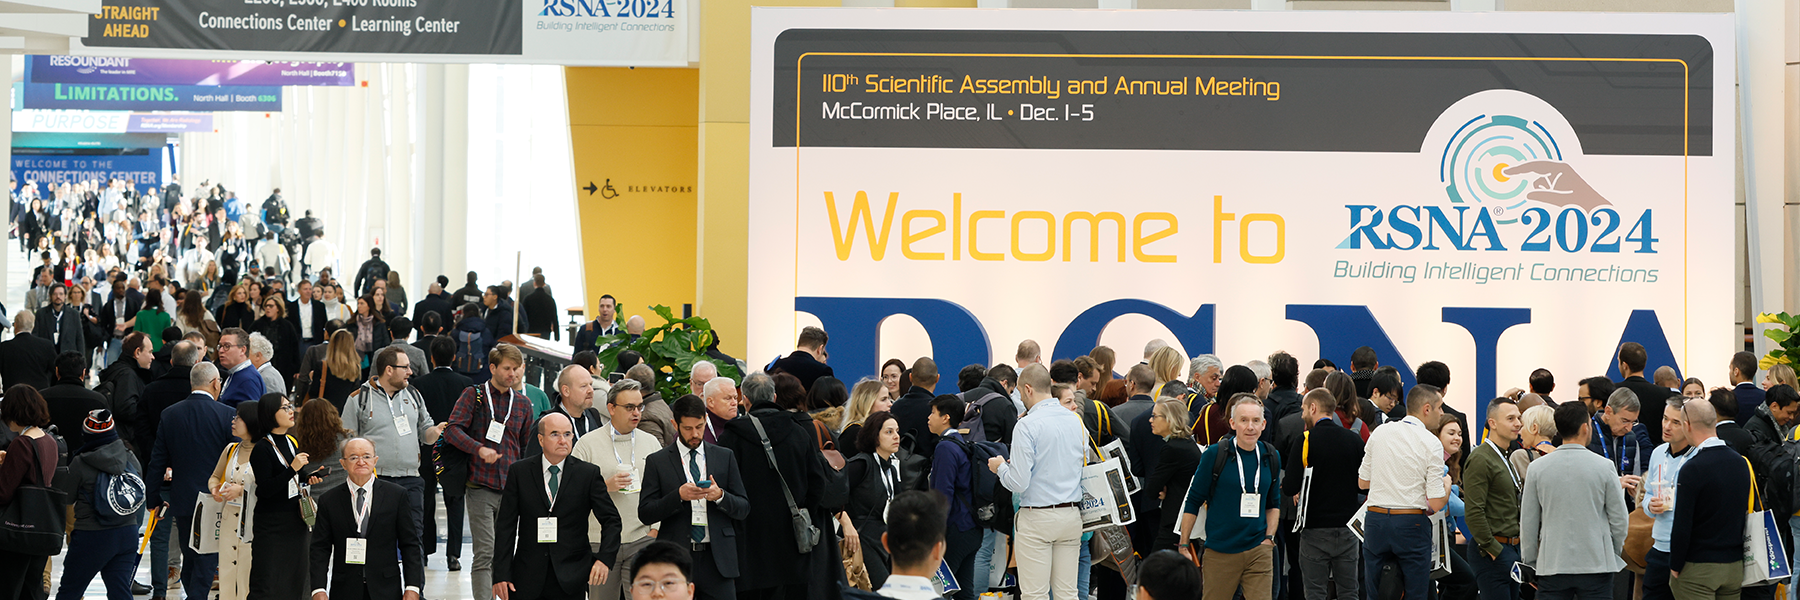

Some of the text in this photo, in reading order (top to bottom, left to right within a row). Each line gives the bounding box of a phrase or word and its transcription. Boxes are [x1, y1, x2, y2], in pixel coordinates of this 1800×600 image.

[537, 0, 675, 18] RSNA 2024
[103, 23, 149, 38] AHEAD
[198, 11, 460, 36] Connections Center Learning Center
[536, 21, 675, 32] Building Intelligent Connections
[50, 54, 130, 67] RESOUNDANT
[55, 83, 179, 102] LIMITATIONS.
[822, 73, 1280, 101] 110th Scientific Assembly and Annual Meeting
[193, 94, 213, 102] North
[215, 94, 229, 102] Hall
[235, 94, 257, 103] Booth
[822, 102, 920, 121] McCormick
[927, 103, 980, 122] Place,
[986, 103, 1003, 120] IL
[1020, 104, 1059, 121] Dec.
[32, 114, 120, 129] PURPOSE
[15, 160, 113, 169] WELCOME TO THE
[23, 170, 107, 183] CONNECTIONS
[109, 171, 157, 184] CENTER
[628, 185, 692, 193] ELEVATORS
[823, 190, 1286, 264] Welcome to
[1520, 207, 1660, 254] 2024
[1333, 260, 1659, 285] Building Intelligent Connections
